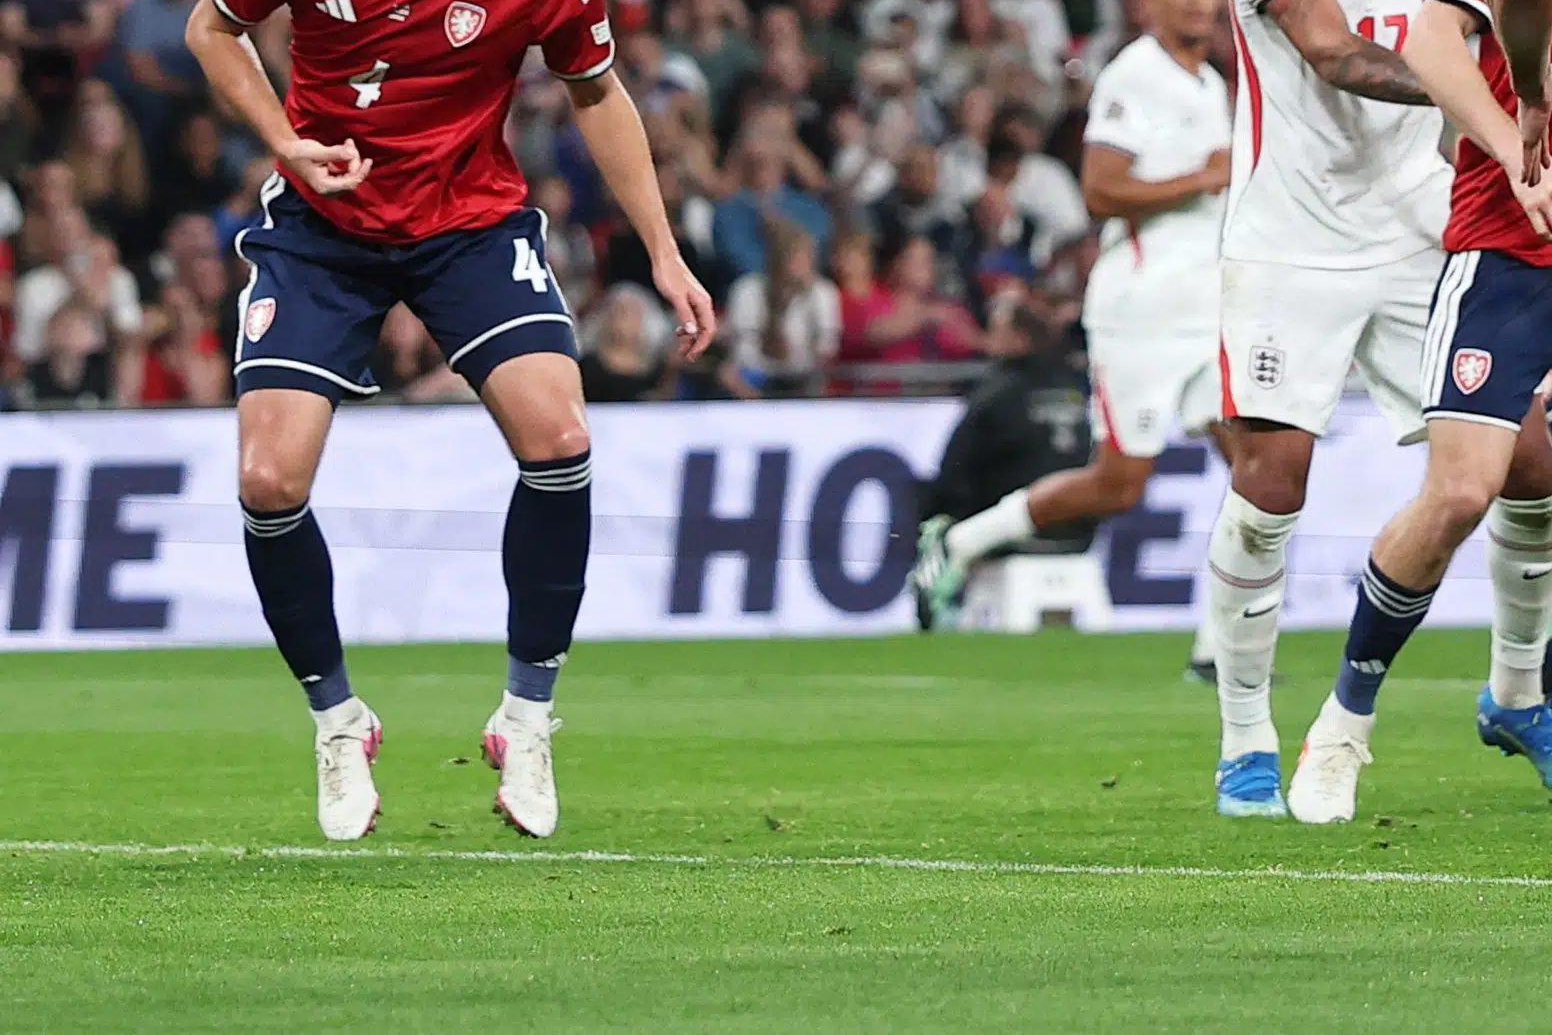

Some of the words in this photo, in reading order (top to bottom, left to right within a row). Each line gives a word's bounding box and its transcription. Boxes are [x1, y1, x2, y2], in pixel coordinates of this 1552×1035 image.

[349, 60, 390, 109] 4
[511, 237, 549, 293] 4
[668, 447, 1208, 614] HOE
